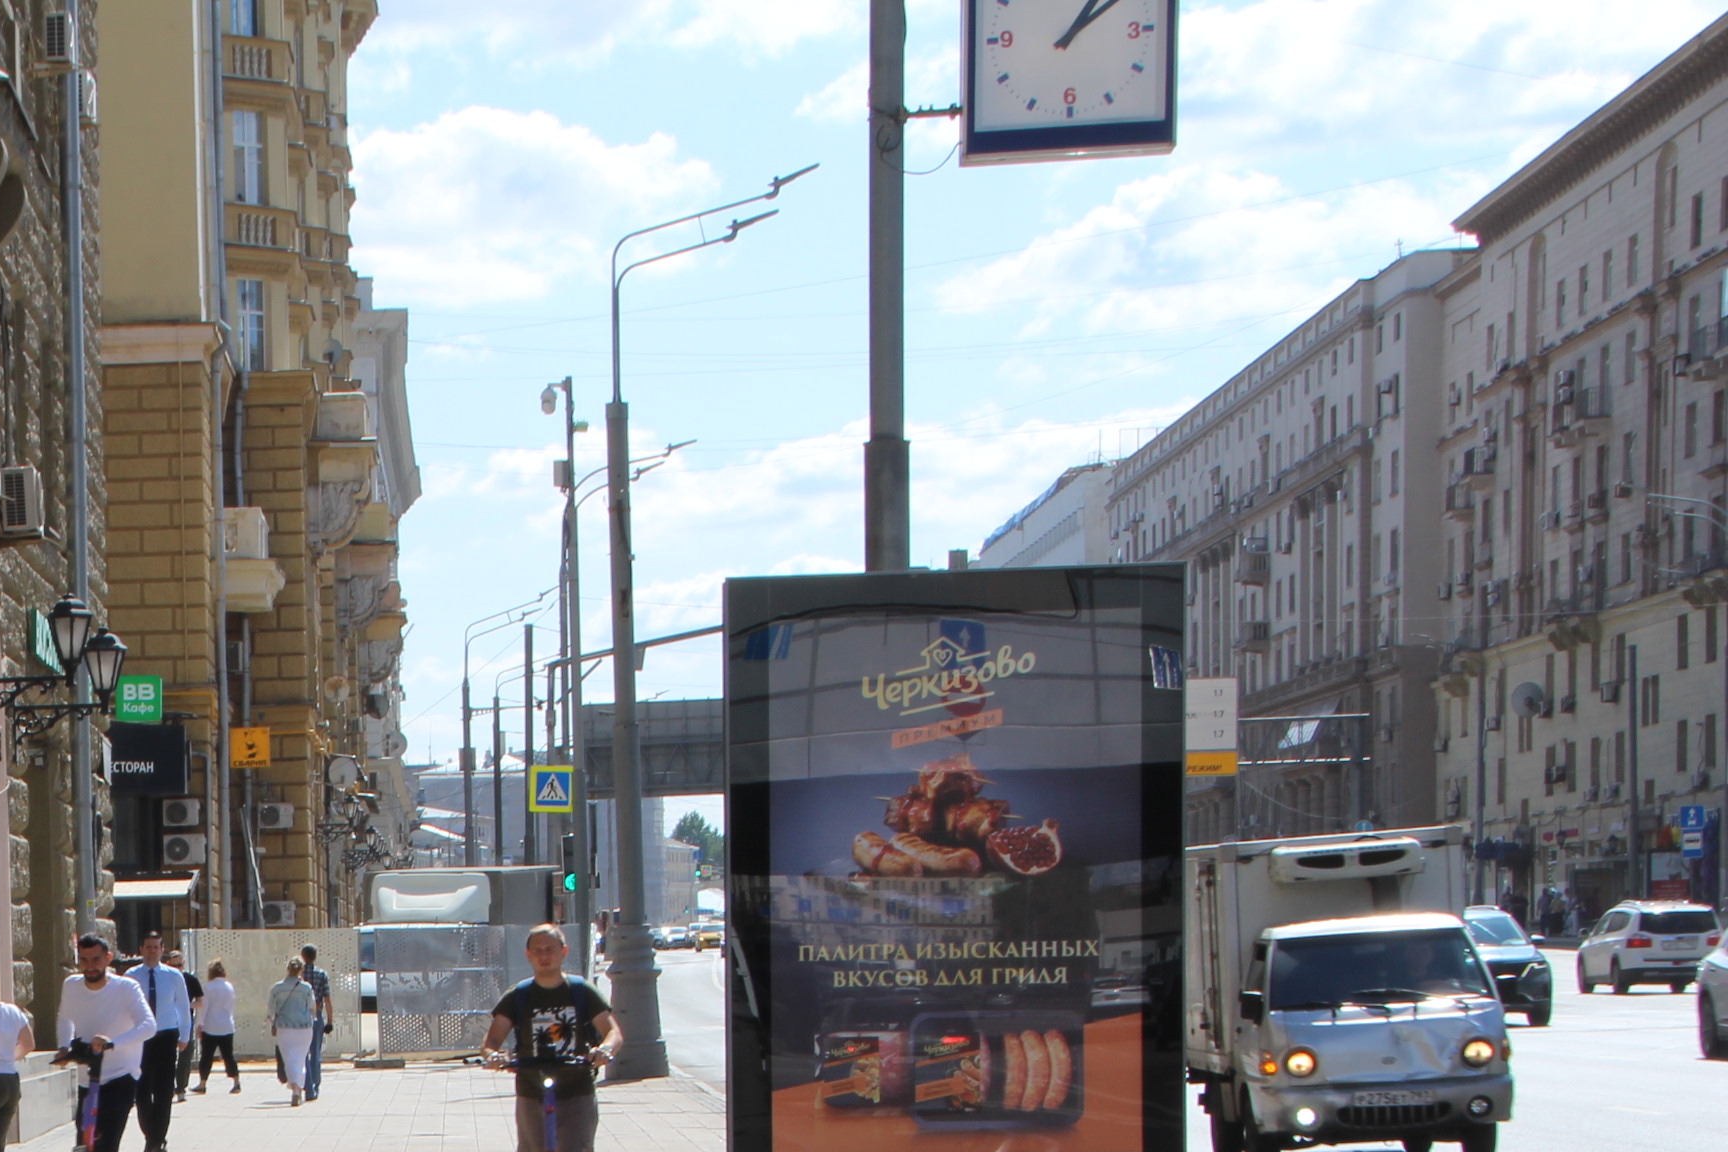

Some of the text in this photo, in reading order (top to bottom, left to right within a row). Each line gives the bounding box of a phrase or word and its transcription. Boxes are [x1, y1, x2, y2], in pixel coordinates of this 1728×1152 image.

[999, 30, 1013, 47] 9
[1127, 21, 1141, 39] 3
[1063, 87, 1076, 105] 6
[861, 645, 1036, 710] Черкизово
[123, 702, 155, 716] Кафе
[898, 714, 997, 745] ПРЕМИУМ
[110, 761, 154, 774] ЕСТОРАН
[797, 939, 1100, 962] ПАЛИТРА ИЗЫСКАННЫХ
[832, 966, 1068, 988] ВКУСОВ ДЛЯ ГРИЛЯ
